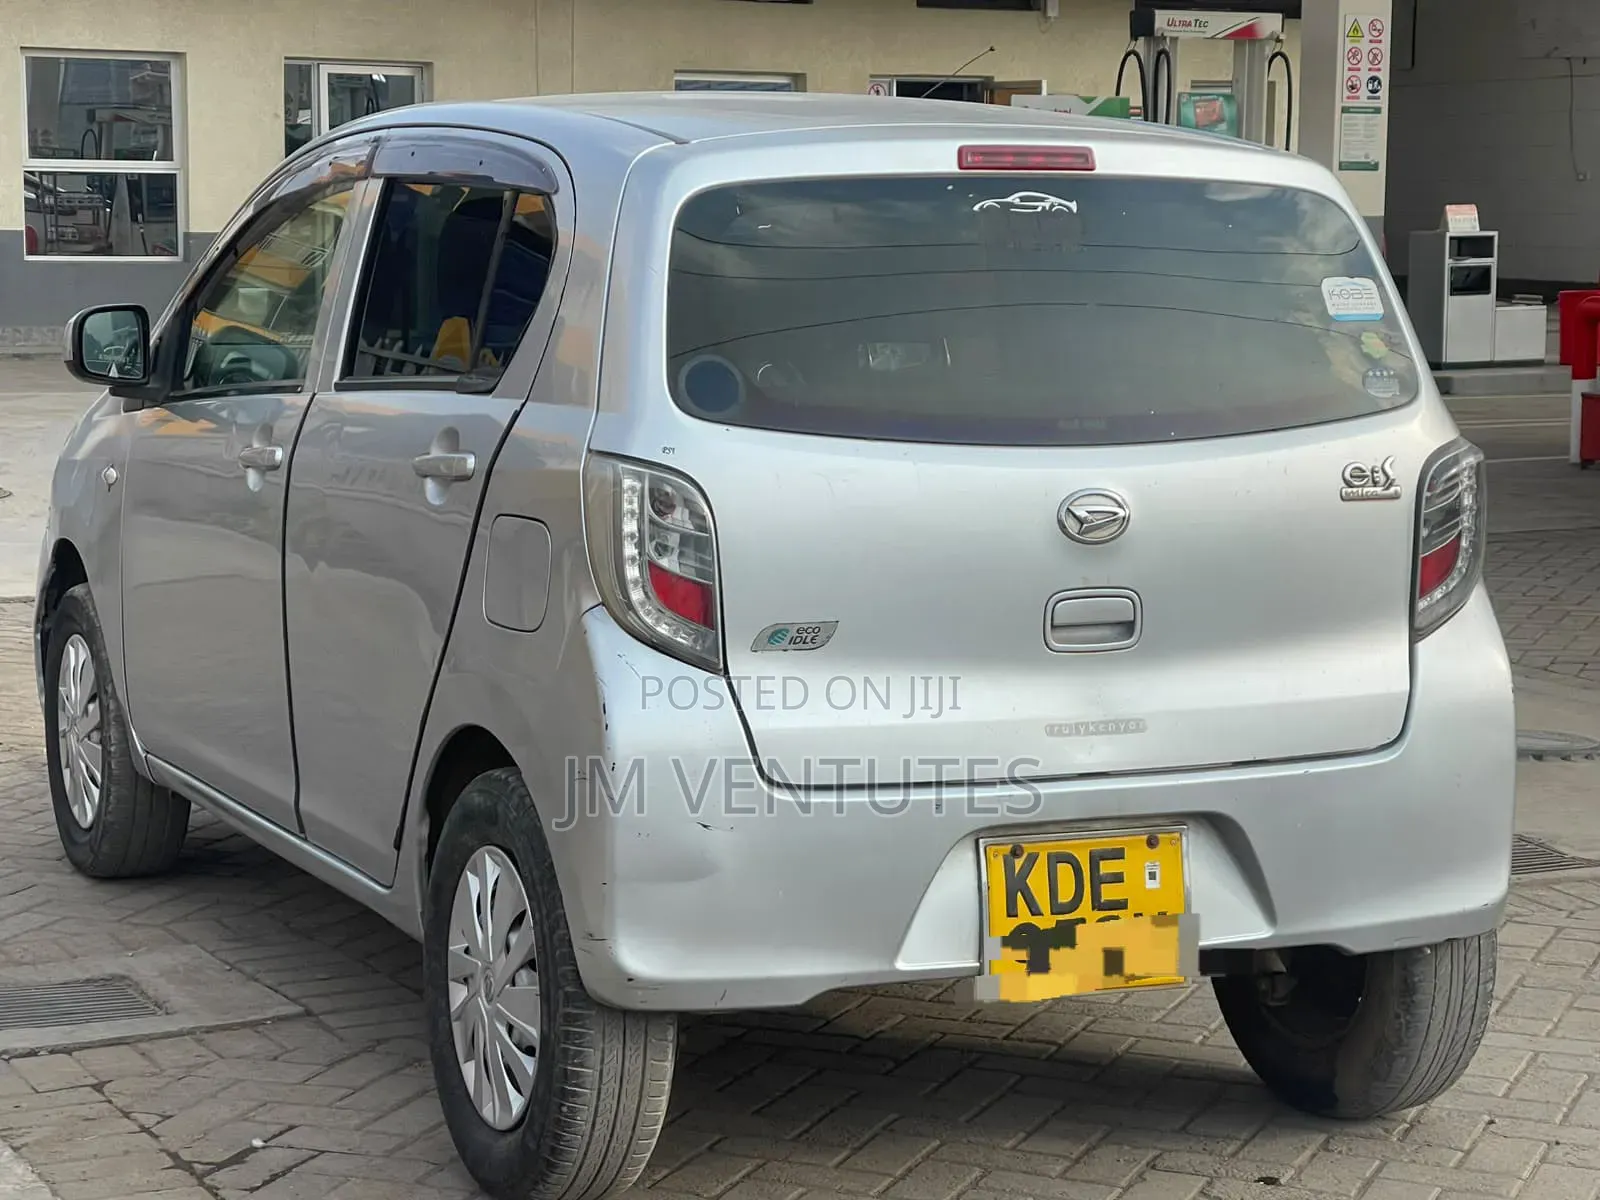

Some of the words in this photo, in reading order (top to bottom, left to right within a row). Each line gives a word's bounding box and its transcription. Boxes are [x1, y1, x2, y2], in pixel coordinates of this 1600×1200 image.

[1194, 18, 1209, 28] TEC
[796, 626, 821, 635] eco
[788, 635, 819, 645] IDLE
[1002, 847, 1129, 918] KDE
